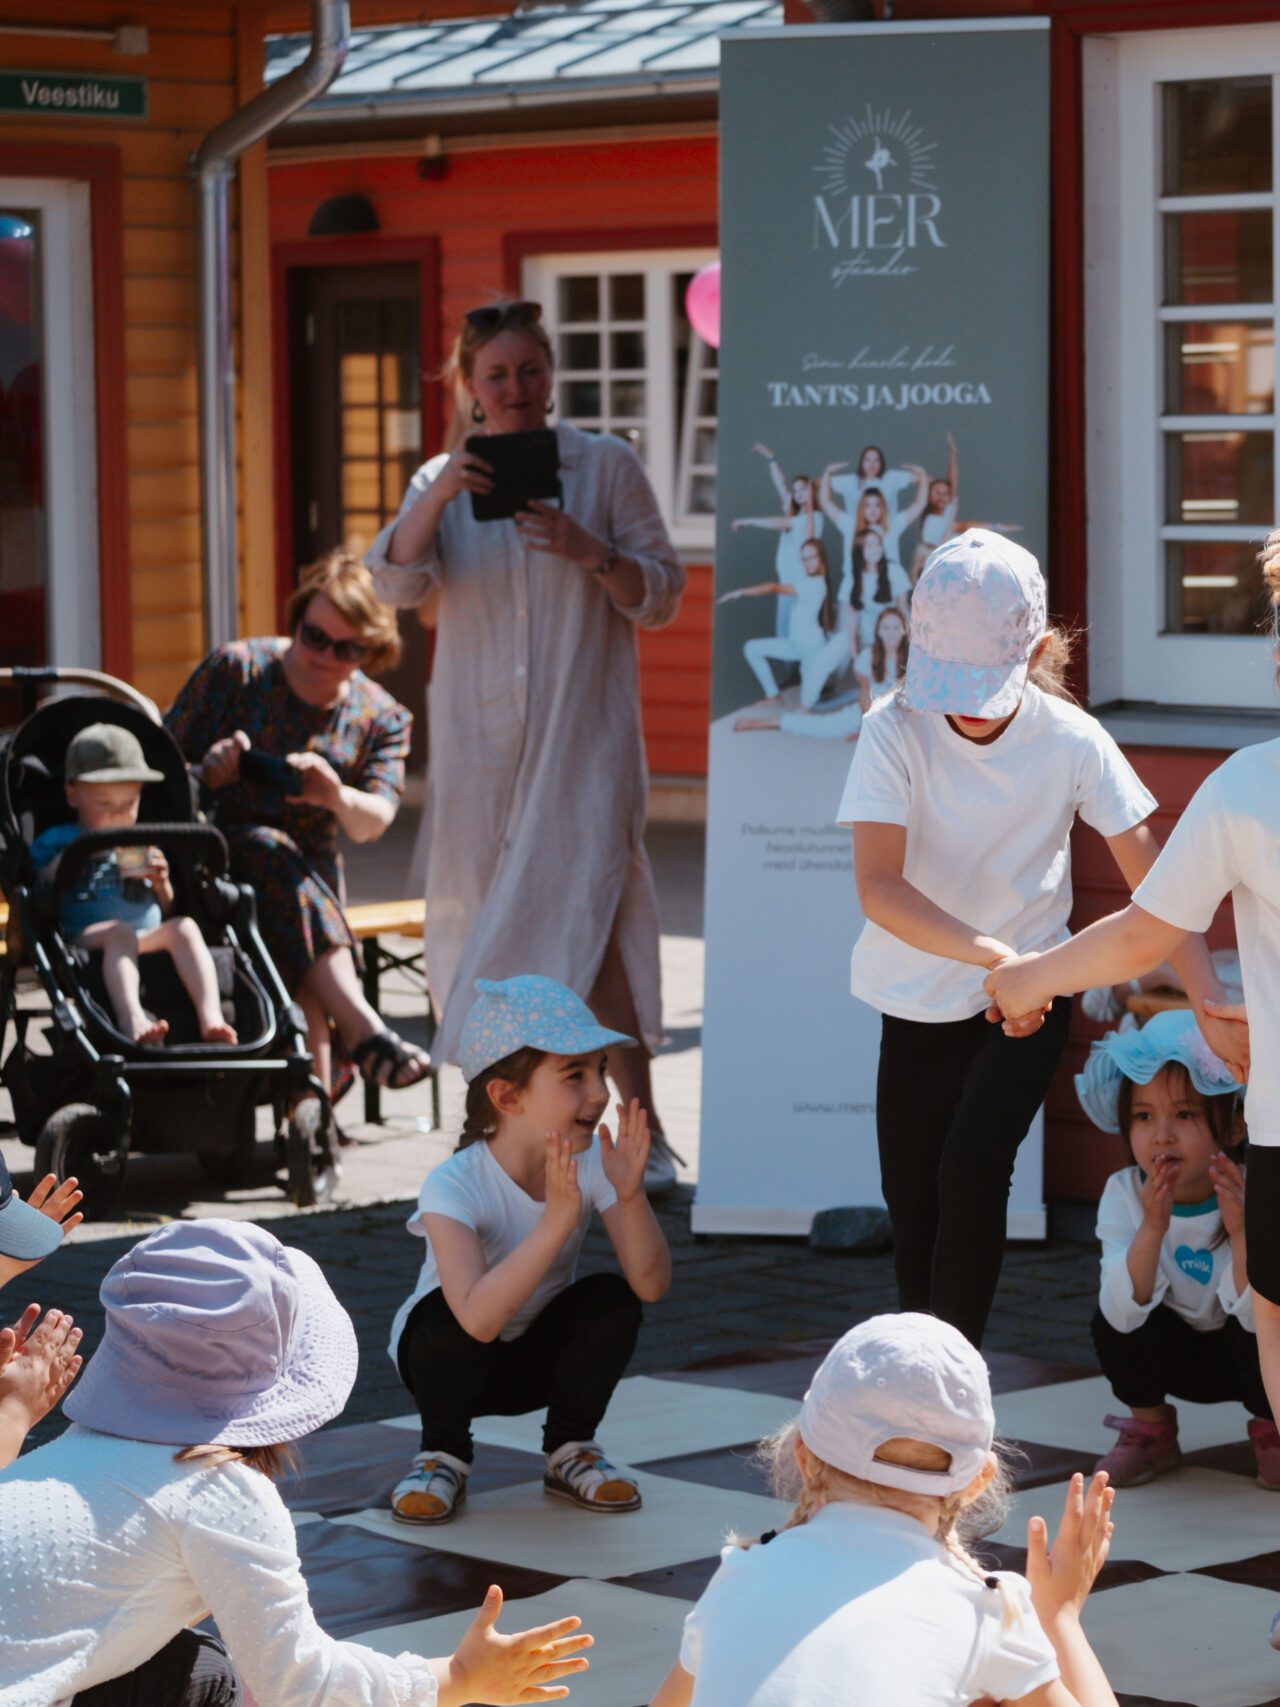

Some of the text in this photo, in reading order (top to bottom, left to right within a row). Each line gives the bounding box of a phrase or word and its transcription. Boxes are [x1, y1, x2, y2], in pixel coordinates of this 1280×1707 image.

[21, 79, 119, 109] Veestiku
[814, 193, 948, 248] MER
[767, 381, 993, 412] TANTS JA JOOGA
[1181, 1257, 1211, 1274] milk
